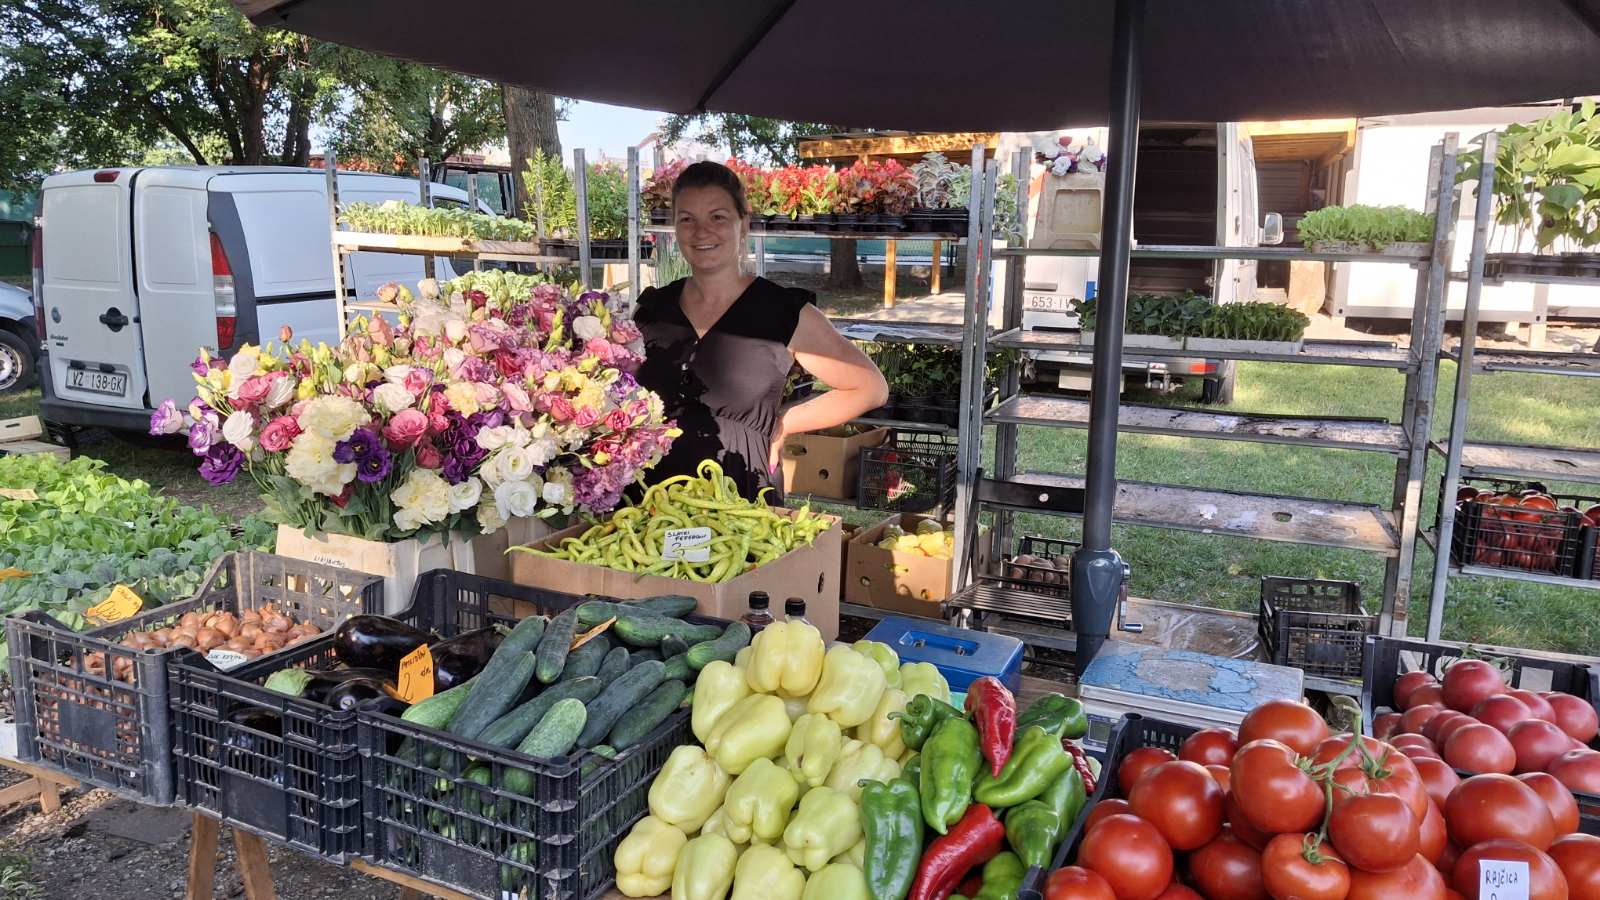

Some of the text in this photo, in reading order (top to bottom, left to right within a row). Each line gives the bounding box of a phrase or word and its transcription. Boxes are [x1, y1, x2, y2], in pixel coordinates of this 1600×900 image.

[73, 371, 123, 392] VZ 138-GK
[403, 672, 414, 702] 2
[1485, 867, 1519, 888] RAJČICA
